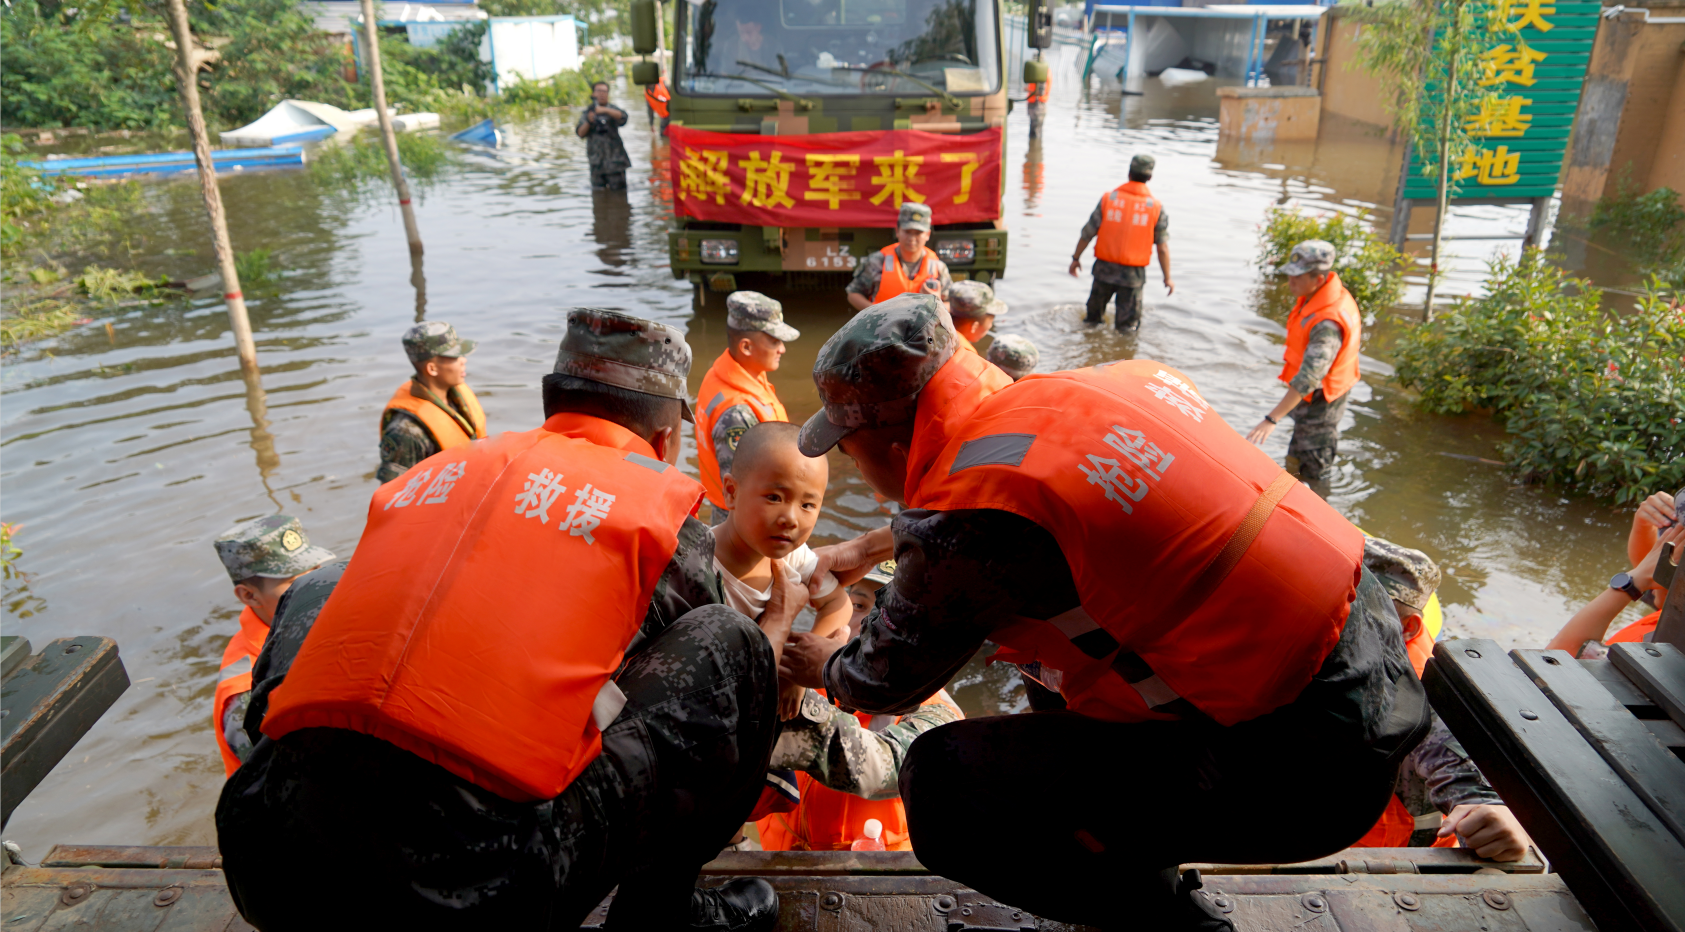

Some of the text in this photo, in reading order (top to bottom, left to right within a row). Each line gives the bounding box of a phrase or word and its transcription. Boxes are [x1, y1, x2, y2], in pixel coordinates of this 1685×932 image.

[678, 146, 989, 210] 解放军来了
[826, 245, 850, 257] LZ
[383, 460, 616, 546] 抢险 救援
[1077, 424, 1176, 515] 抢险
